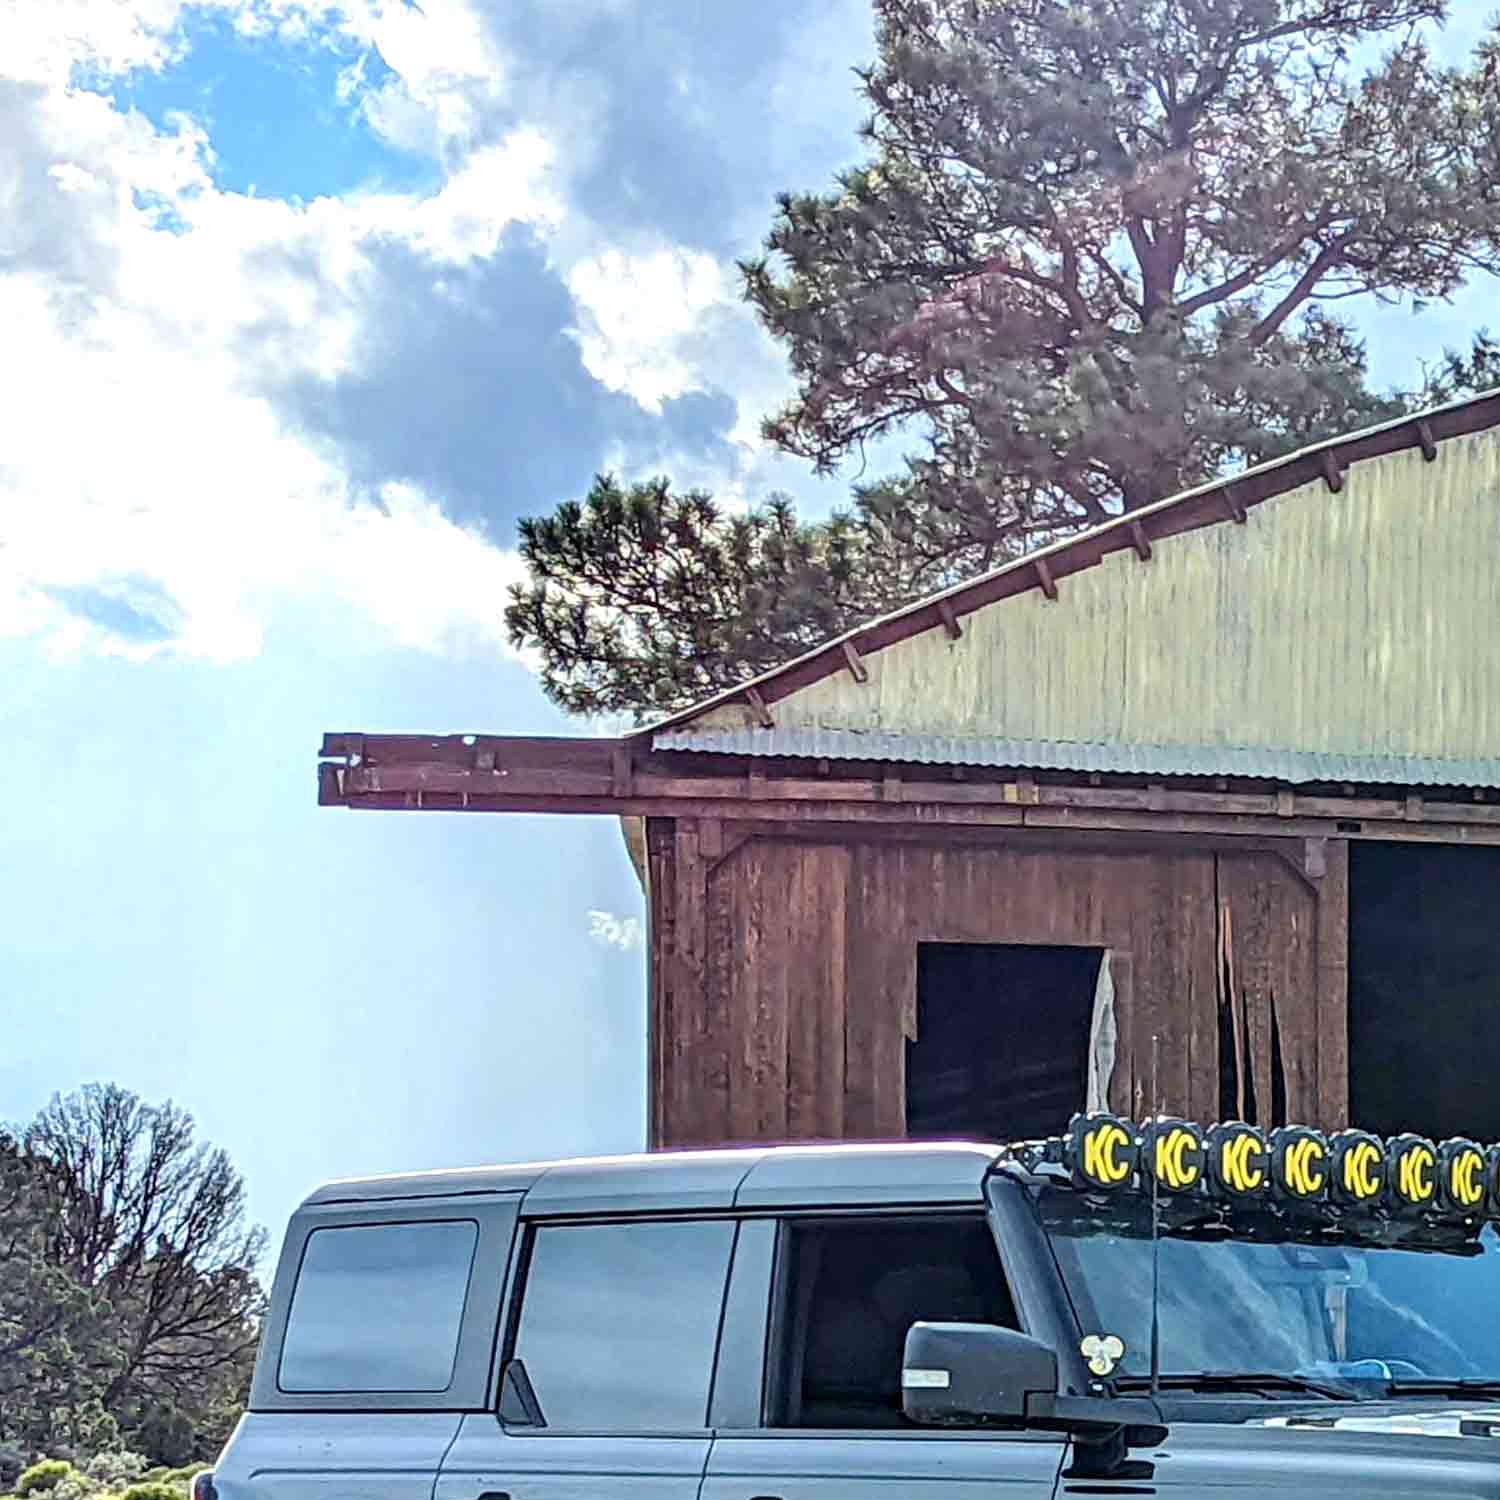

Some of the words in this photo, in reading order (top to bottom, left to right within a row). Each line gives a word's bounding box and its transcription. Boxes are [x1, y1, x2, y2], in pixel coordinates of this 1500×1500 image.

[1084, 1124, 1130, 1184] KC
[1156, 1129, 1199, 1188] KC
[1222, 1134, 1263, 1192] KC
[1285, 1138, 1324, 1195] KC
[1344, 1142, 1381, 1198] KC
[1400, 1146, 1434, 1202] KC
[1451, 1150, 1484, 1205] KC
